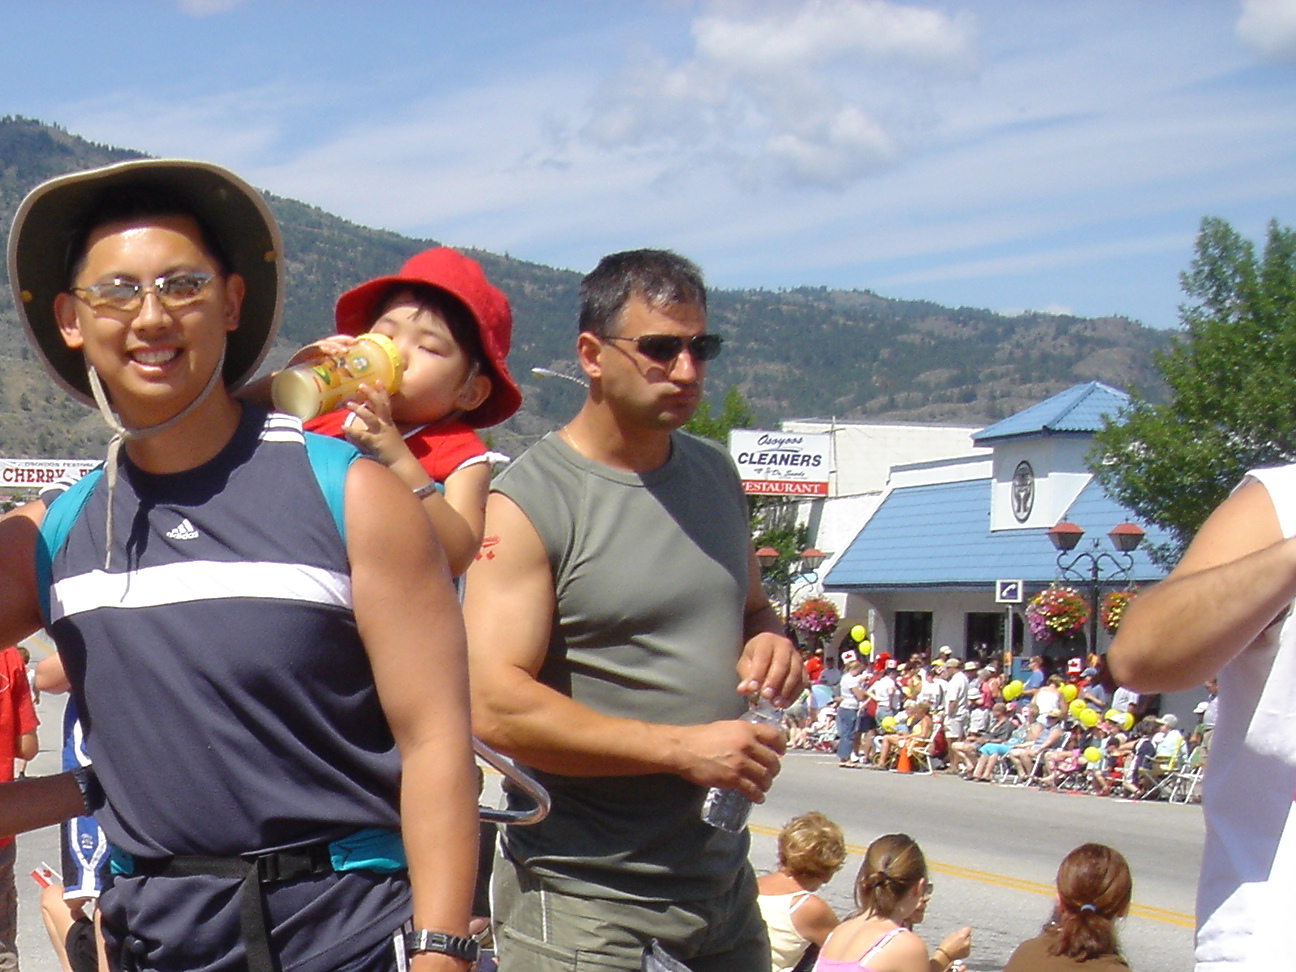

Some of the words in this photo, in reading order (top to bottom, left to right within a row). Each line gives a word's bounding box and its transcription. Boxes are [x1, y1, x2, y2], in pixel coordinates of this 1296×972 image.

[757, 434, 803, 449] Osoyoos
[738, 452, 822, 467] CLEANERS
[3, 467, 65, 482] CHERRY
